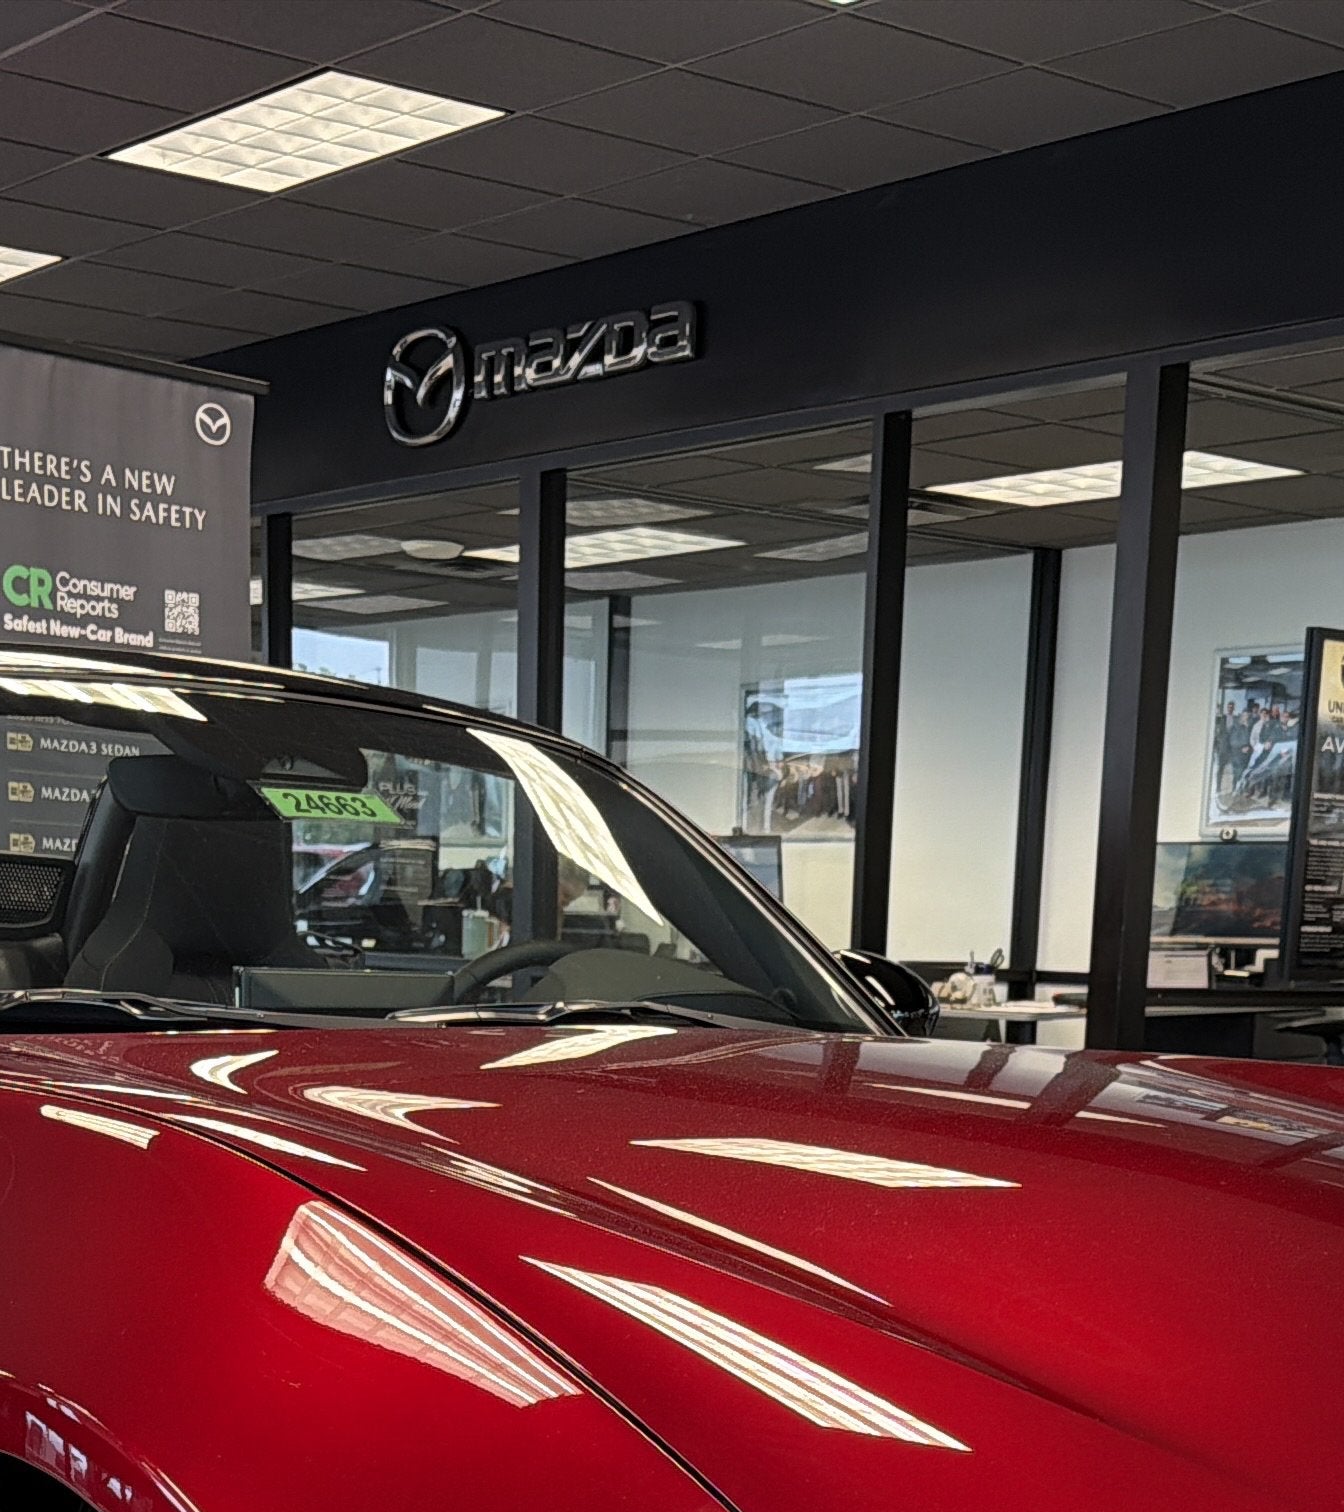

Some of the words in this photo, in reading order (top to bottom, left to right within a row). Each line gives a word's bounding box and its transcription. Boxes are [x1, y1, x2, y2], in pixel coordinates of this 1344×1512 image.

[473, 301, 696, 399] mazda
[0, 445, 92, 483] THERE'S
[100, 464, 117, 487] A
[124, 467, 175, 496] NEW
[1, 477, 88, 513] LEADER
[97, 492, 121, 517] IN
[129, 498, 206, 531] SAFETY
[3, 564, 54, 610] CR
[56, 571, 137, 601] Consumer
[57, 591, 119, 618] Reports
[3, 613, 48, 635] Safest
[50, 618, 112, 640] New-Car
[114, 626, 153, 647] Brand
[39, 737, 96, 755] MAZDA3
[101, 743, 140, 757] SEDAN
[282, 792, 378, 818] 24663
